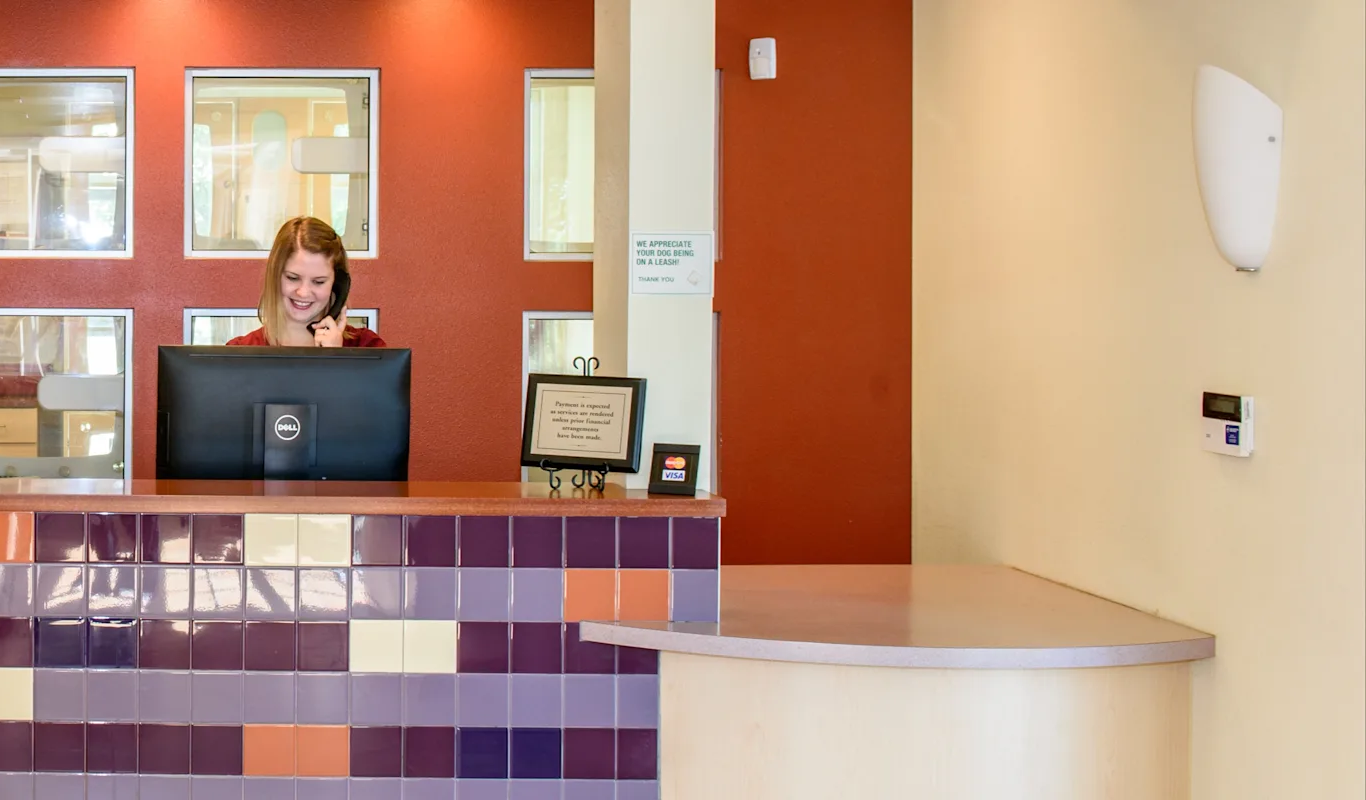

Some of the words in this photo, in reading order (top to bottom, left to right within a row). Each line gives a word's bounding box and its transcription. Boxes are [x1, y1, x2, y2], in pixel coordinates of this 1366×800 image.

[636, 240, 647, 248] WE
[649, 240, 692, 248] APPRECIATE
[636, 249, 655, 257] YOUR
[656, 249, 672, 257] DOG
[673, 249, 694, 257] BEING
[636, 258, 646, 266] ON
[647, 258, 653, 266] A
[654, 258, 680, 266] LEASH!
[277, 423, 298, 431] DELL
[665, 471, 684, 479] VISA
